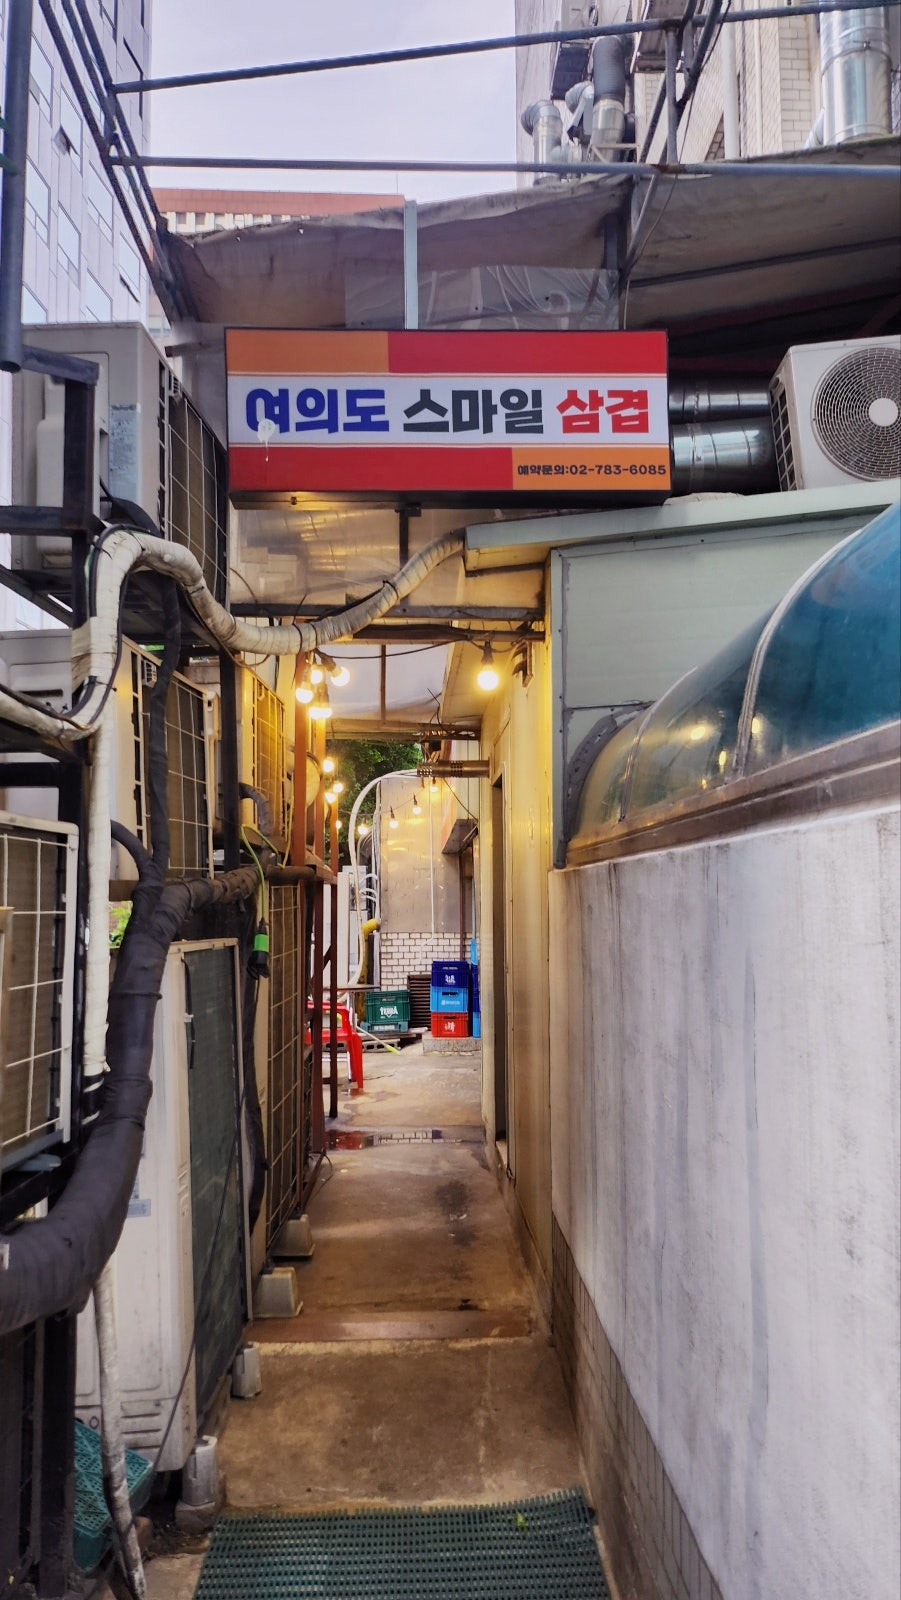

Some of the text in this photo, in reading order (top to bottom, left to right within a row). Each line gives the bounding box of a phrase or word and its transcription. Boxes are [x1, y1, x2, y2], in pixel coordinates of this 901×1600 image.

[246, 388, 649, 434] 여의도 스마일 삼겹
[517, 464, 667, 475] 예약문의:02-783-6085
